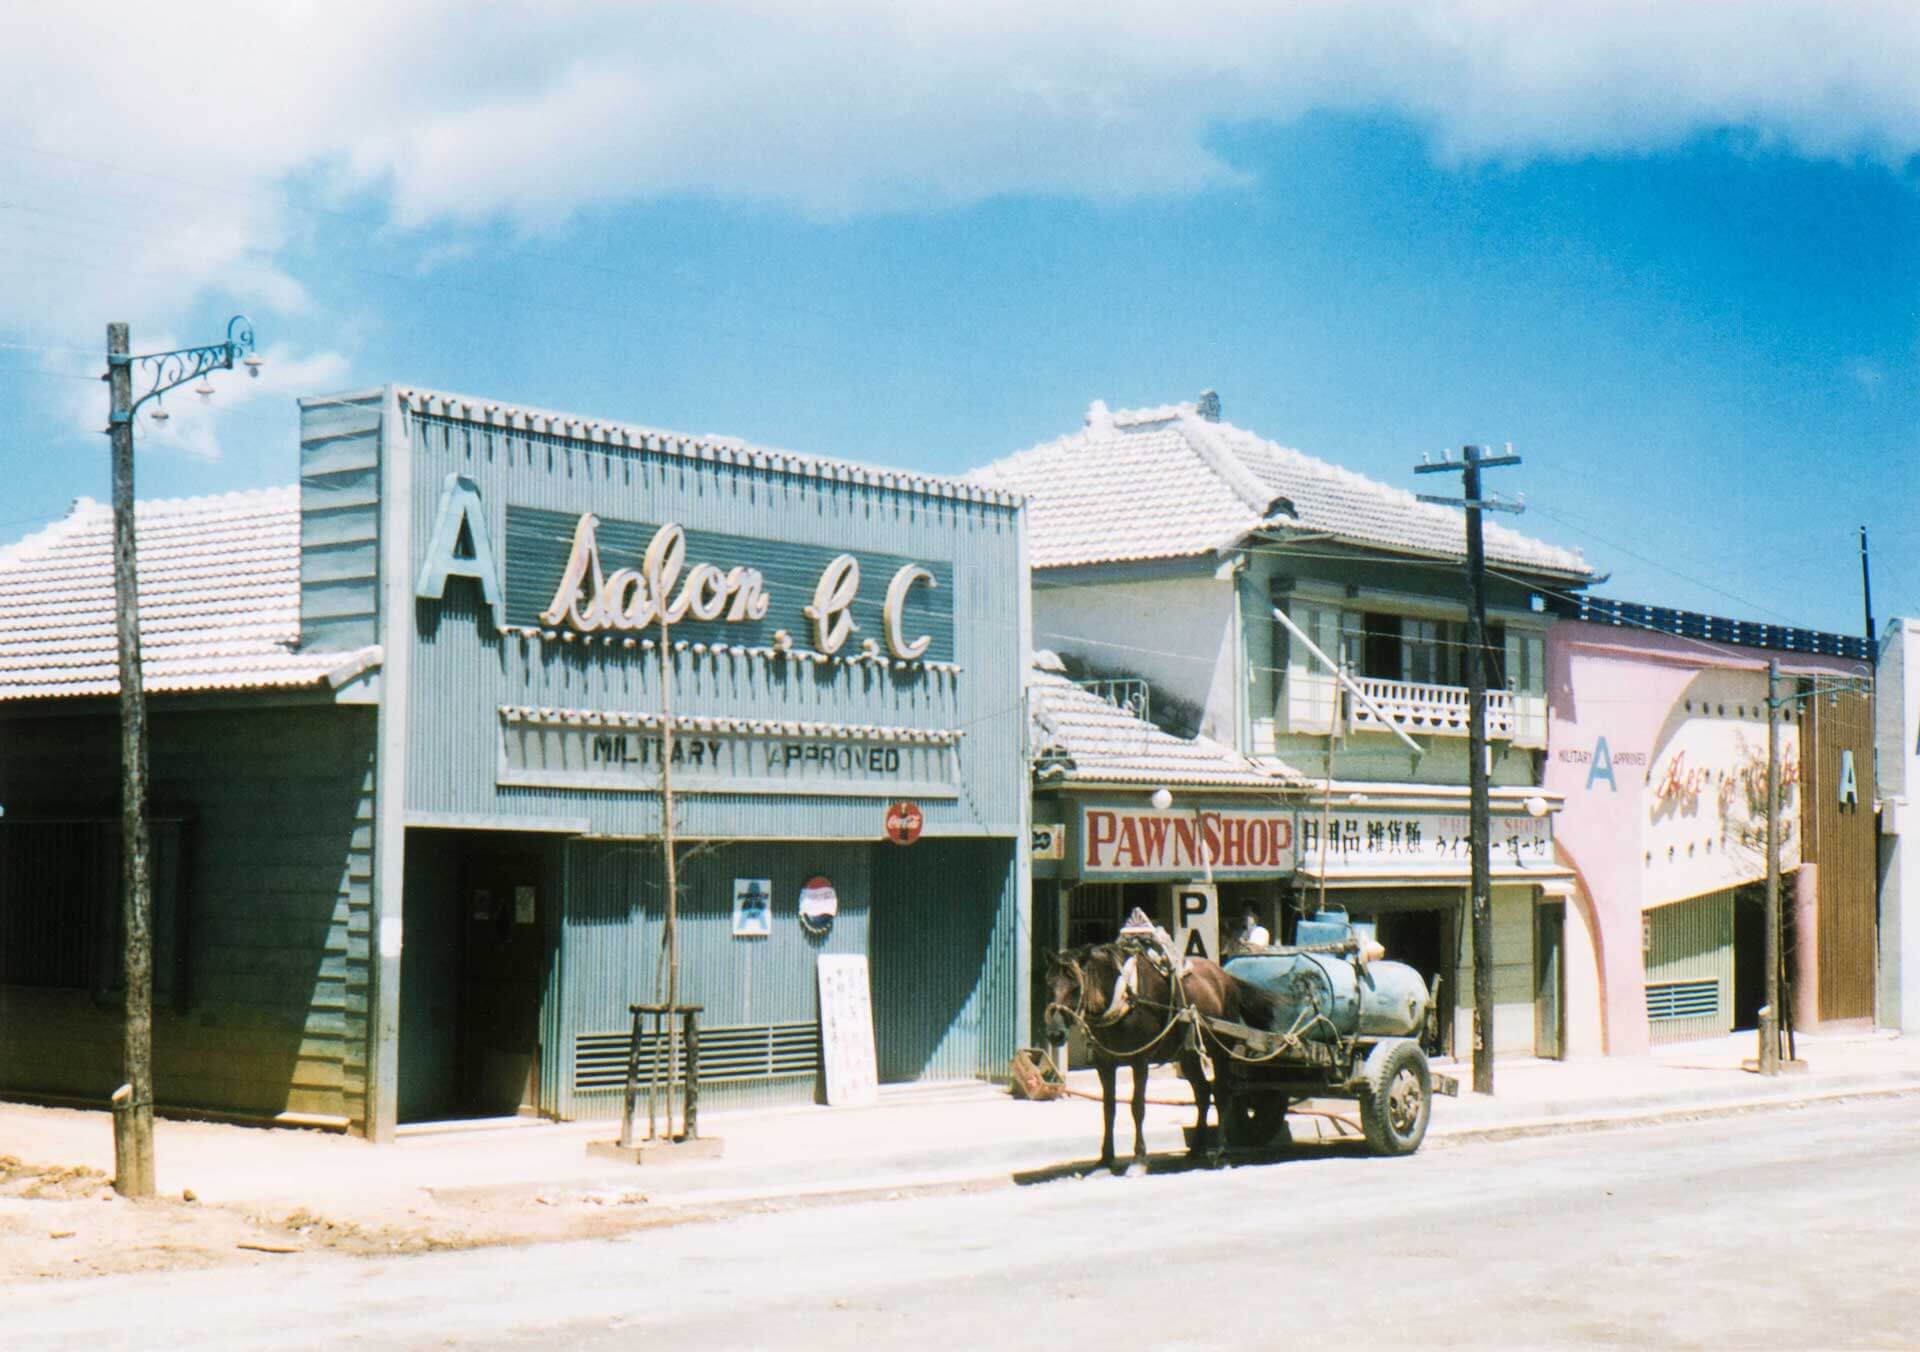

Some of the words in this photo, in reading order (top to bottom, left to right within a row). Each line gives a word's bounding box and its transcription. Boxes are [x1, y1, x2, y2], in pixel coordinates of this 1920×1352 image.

[416, 472, 502, 606] A
[593, 735, 723, 768] MILITARY
[767, 742, 900, 773] APPROVED
[1586, 735, 1617, 792] A
[1839, 750, 1857, 804] A
